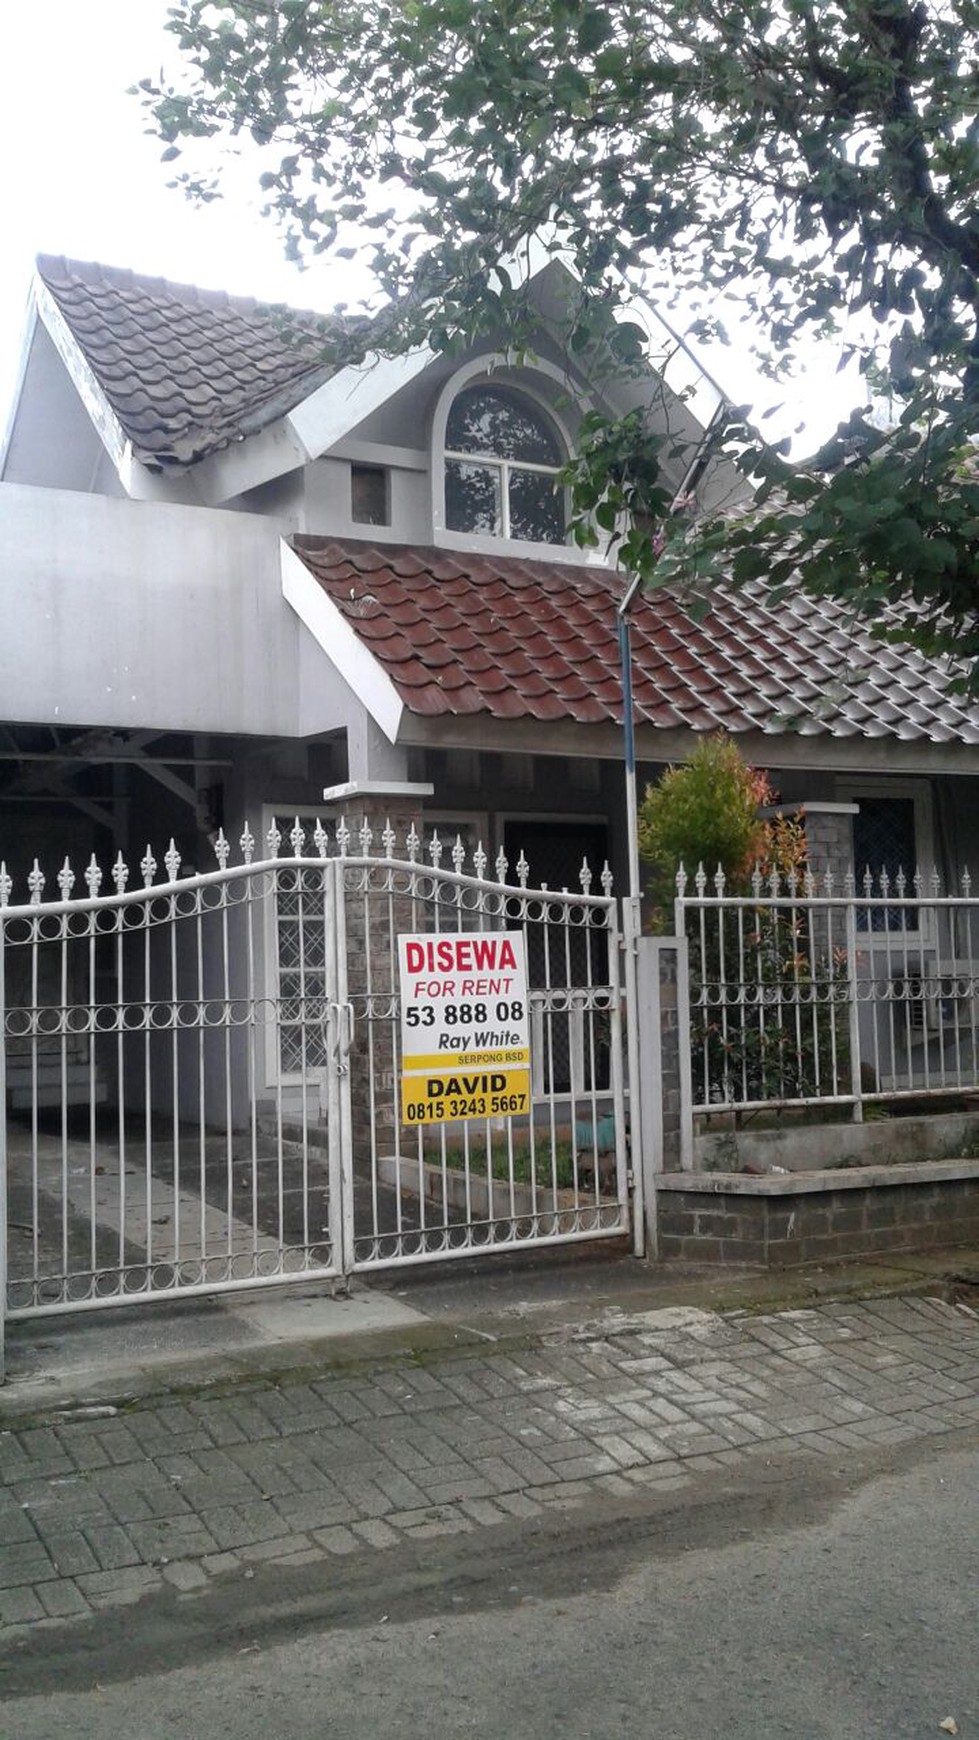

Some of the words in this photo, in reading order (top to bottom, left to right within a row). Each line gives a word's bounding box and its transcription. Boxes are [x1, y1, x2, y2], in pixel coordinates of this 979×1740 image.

[406, 940, 517, 973] DISEWA
[414, 980, 455, 998] FOR
[462, 978, 514, 996] RENT
[406, 1006, 435, 1027] 53
[444, 1003, 487, 1025] 888
[496, 1001, 523, 1022] 08
[438, 1033, 471, 1051] Ray
[474, 1030, 520, 1048] White
[458, 1053, 503, 1064] SERPONG
[505, 1052, 524, 1062] BSD
[427, 1074, 507, 1098] DAVID
[407, 1101, 444, 1121] 0815
[450, 1098, 486, 1117] 3243
[491, 1094, 526, 1113] 5667
